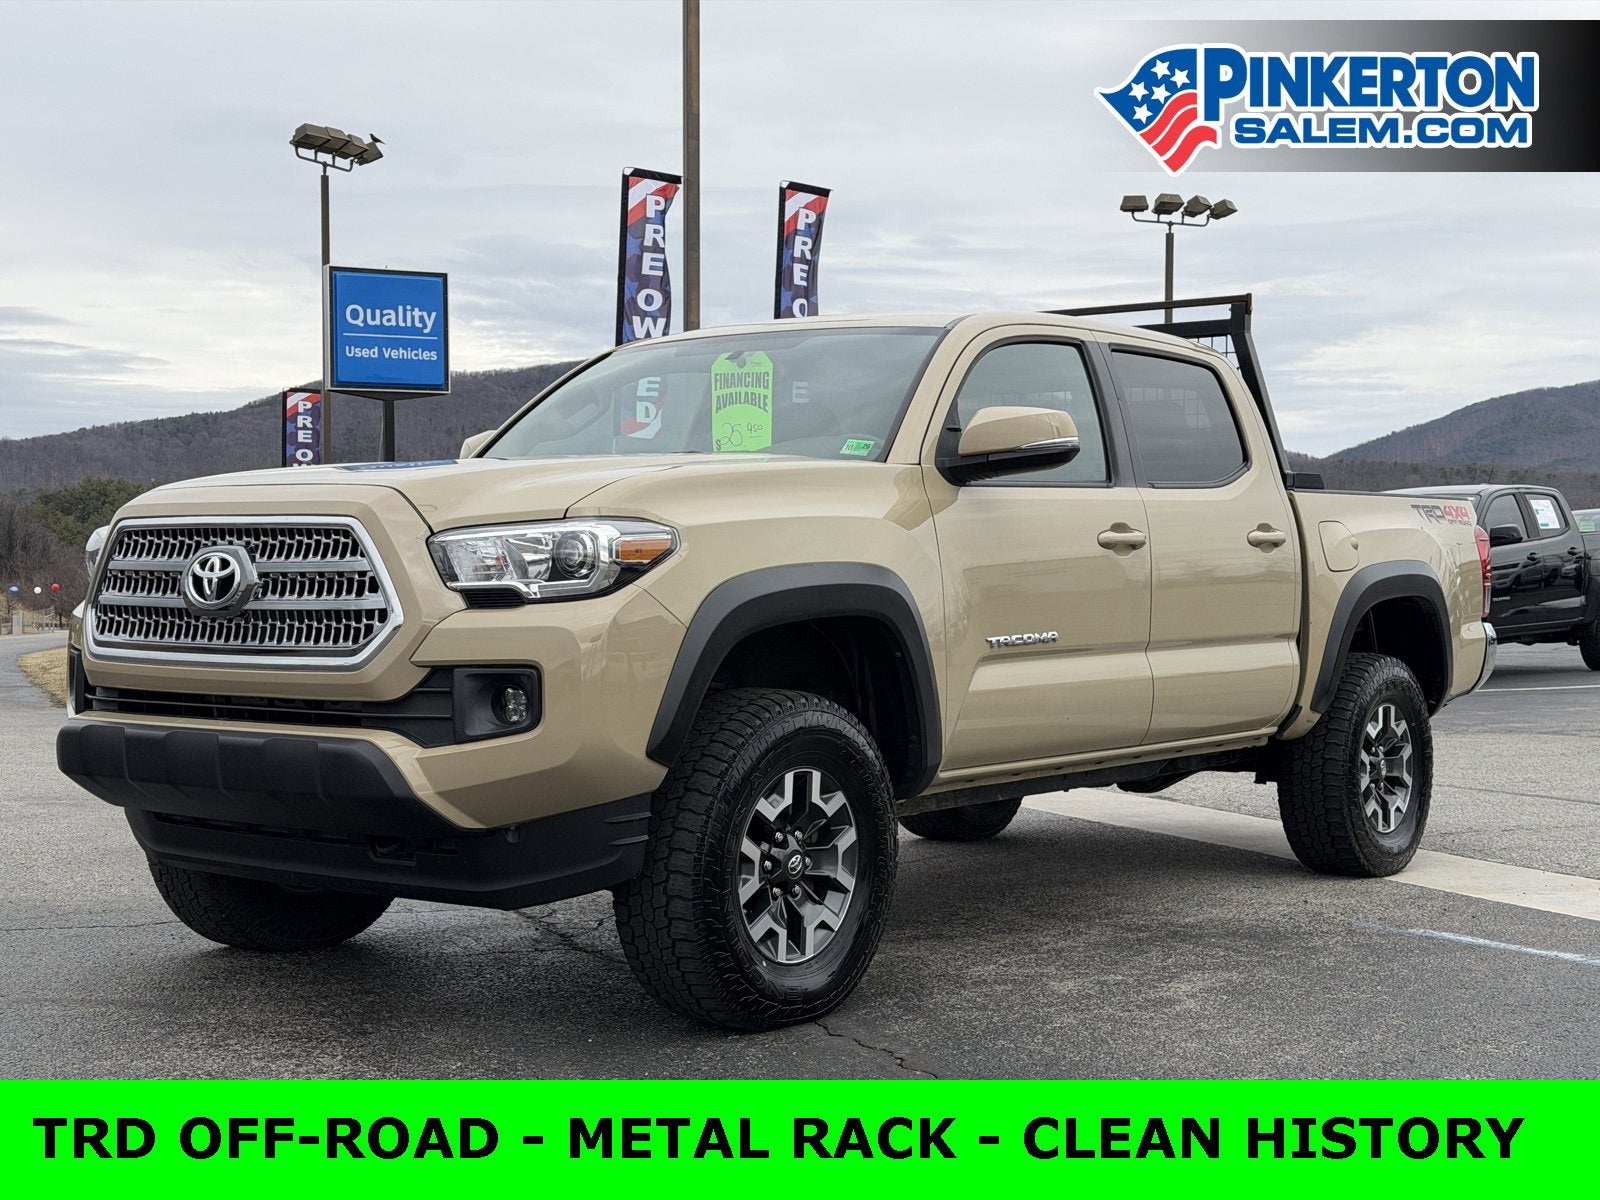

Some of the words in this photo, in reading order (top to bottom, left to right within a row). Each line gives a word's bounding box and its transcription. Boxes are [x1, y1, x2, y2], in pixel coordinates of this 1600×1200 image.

[641, 194, 665, 276] PRE
[792, 207, 817, 287] PRE
[345, 304, 437, 333] Quality
[345, 345, 378, 358] Used
[382, 347, 438, 360] Vehicles
[714, 371, 769, 391] FINANCING
[715, 391, 769, 414] AVAILABLE
[297, 400, 313, 443] PRE
[985, 631, 1059, 649] TACOMA
